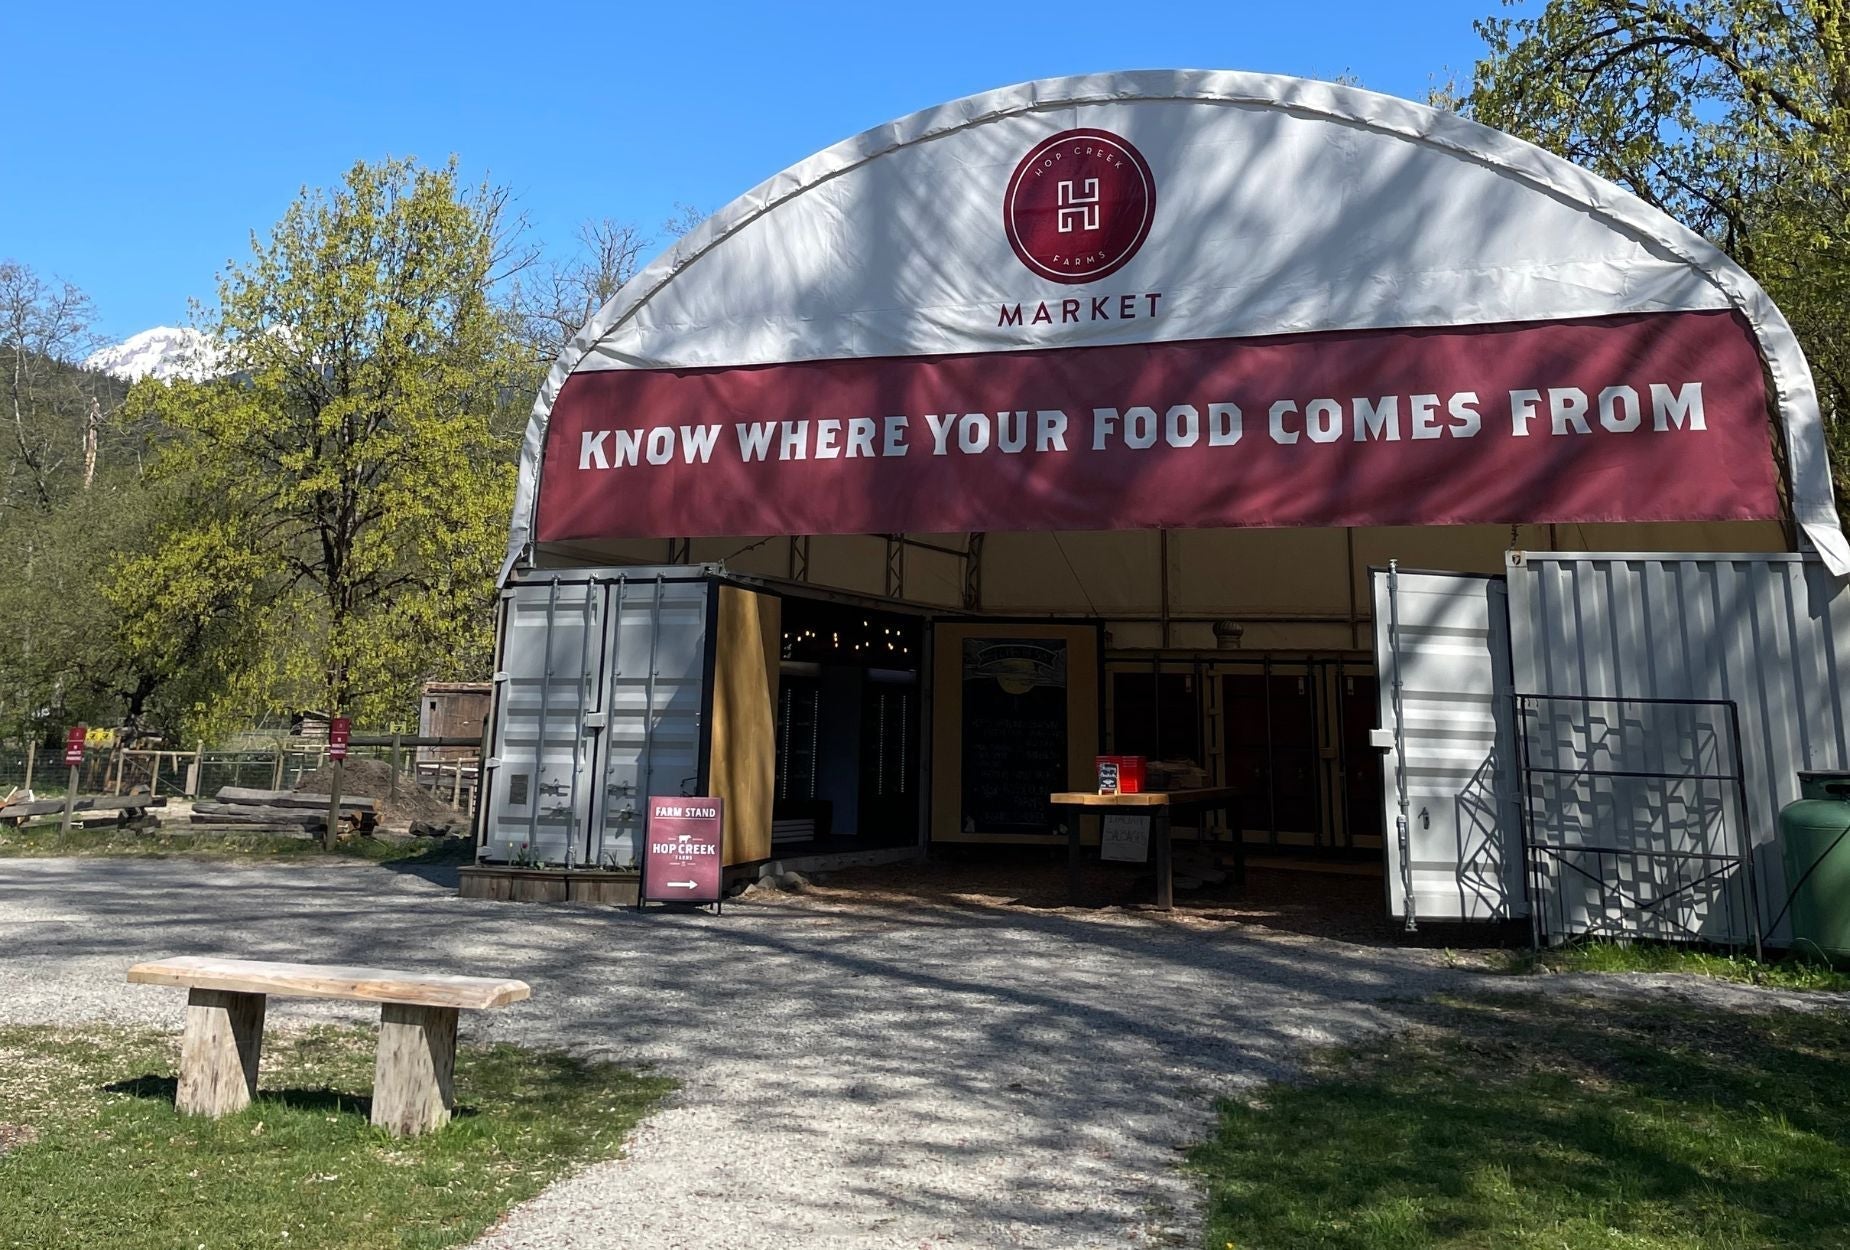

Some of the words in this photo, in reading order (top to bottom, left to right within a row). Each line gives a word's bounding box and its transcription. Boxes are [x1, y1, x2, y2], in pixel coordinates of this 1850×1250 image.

[1035, 153, 1061, 176] HOP
[1074, 147, 1123, 168] CREEK
[1053, 251, 1105, 266] FARMS
[997, 293, 1162, 328] MARKET
[578, 424, 723, 470] KNOW
[735, 415, 910, 463] WHERE
[924, 410, 1069, 455] YOUR
[1091, 402, 1243, 450] FOOD
[1268, 391, 1482, 445] COMES
[1508, 381, 1708, 436] FROM
[655, 807, 682, 817] FARM
[685, 808, 716, 817] STAND
[652, 843, 676, 853] HOP
[678, 844, 715, 854] CREEK
